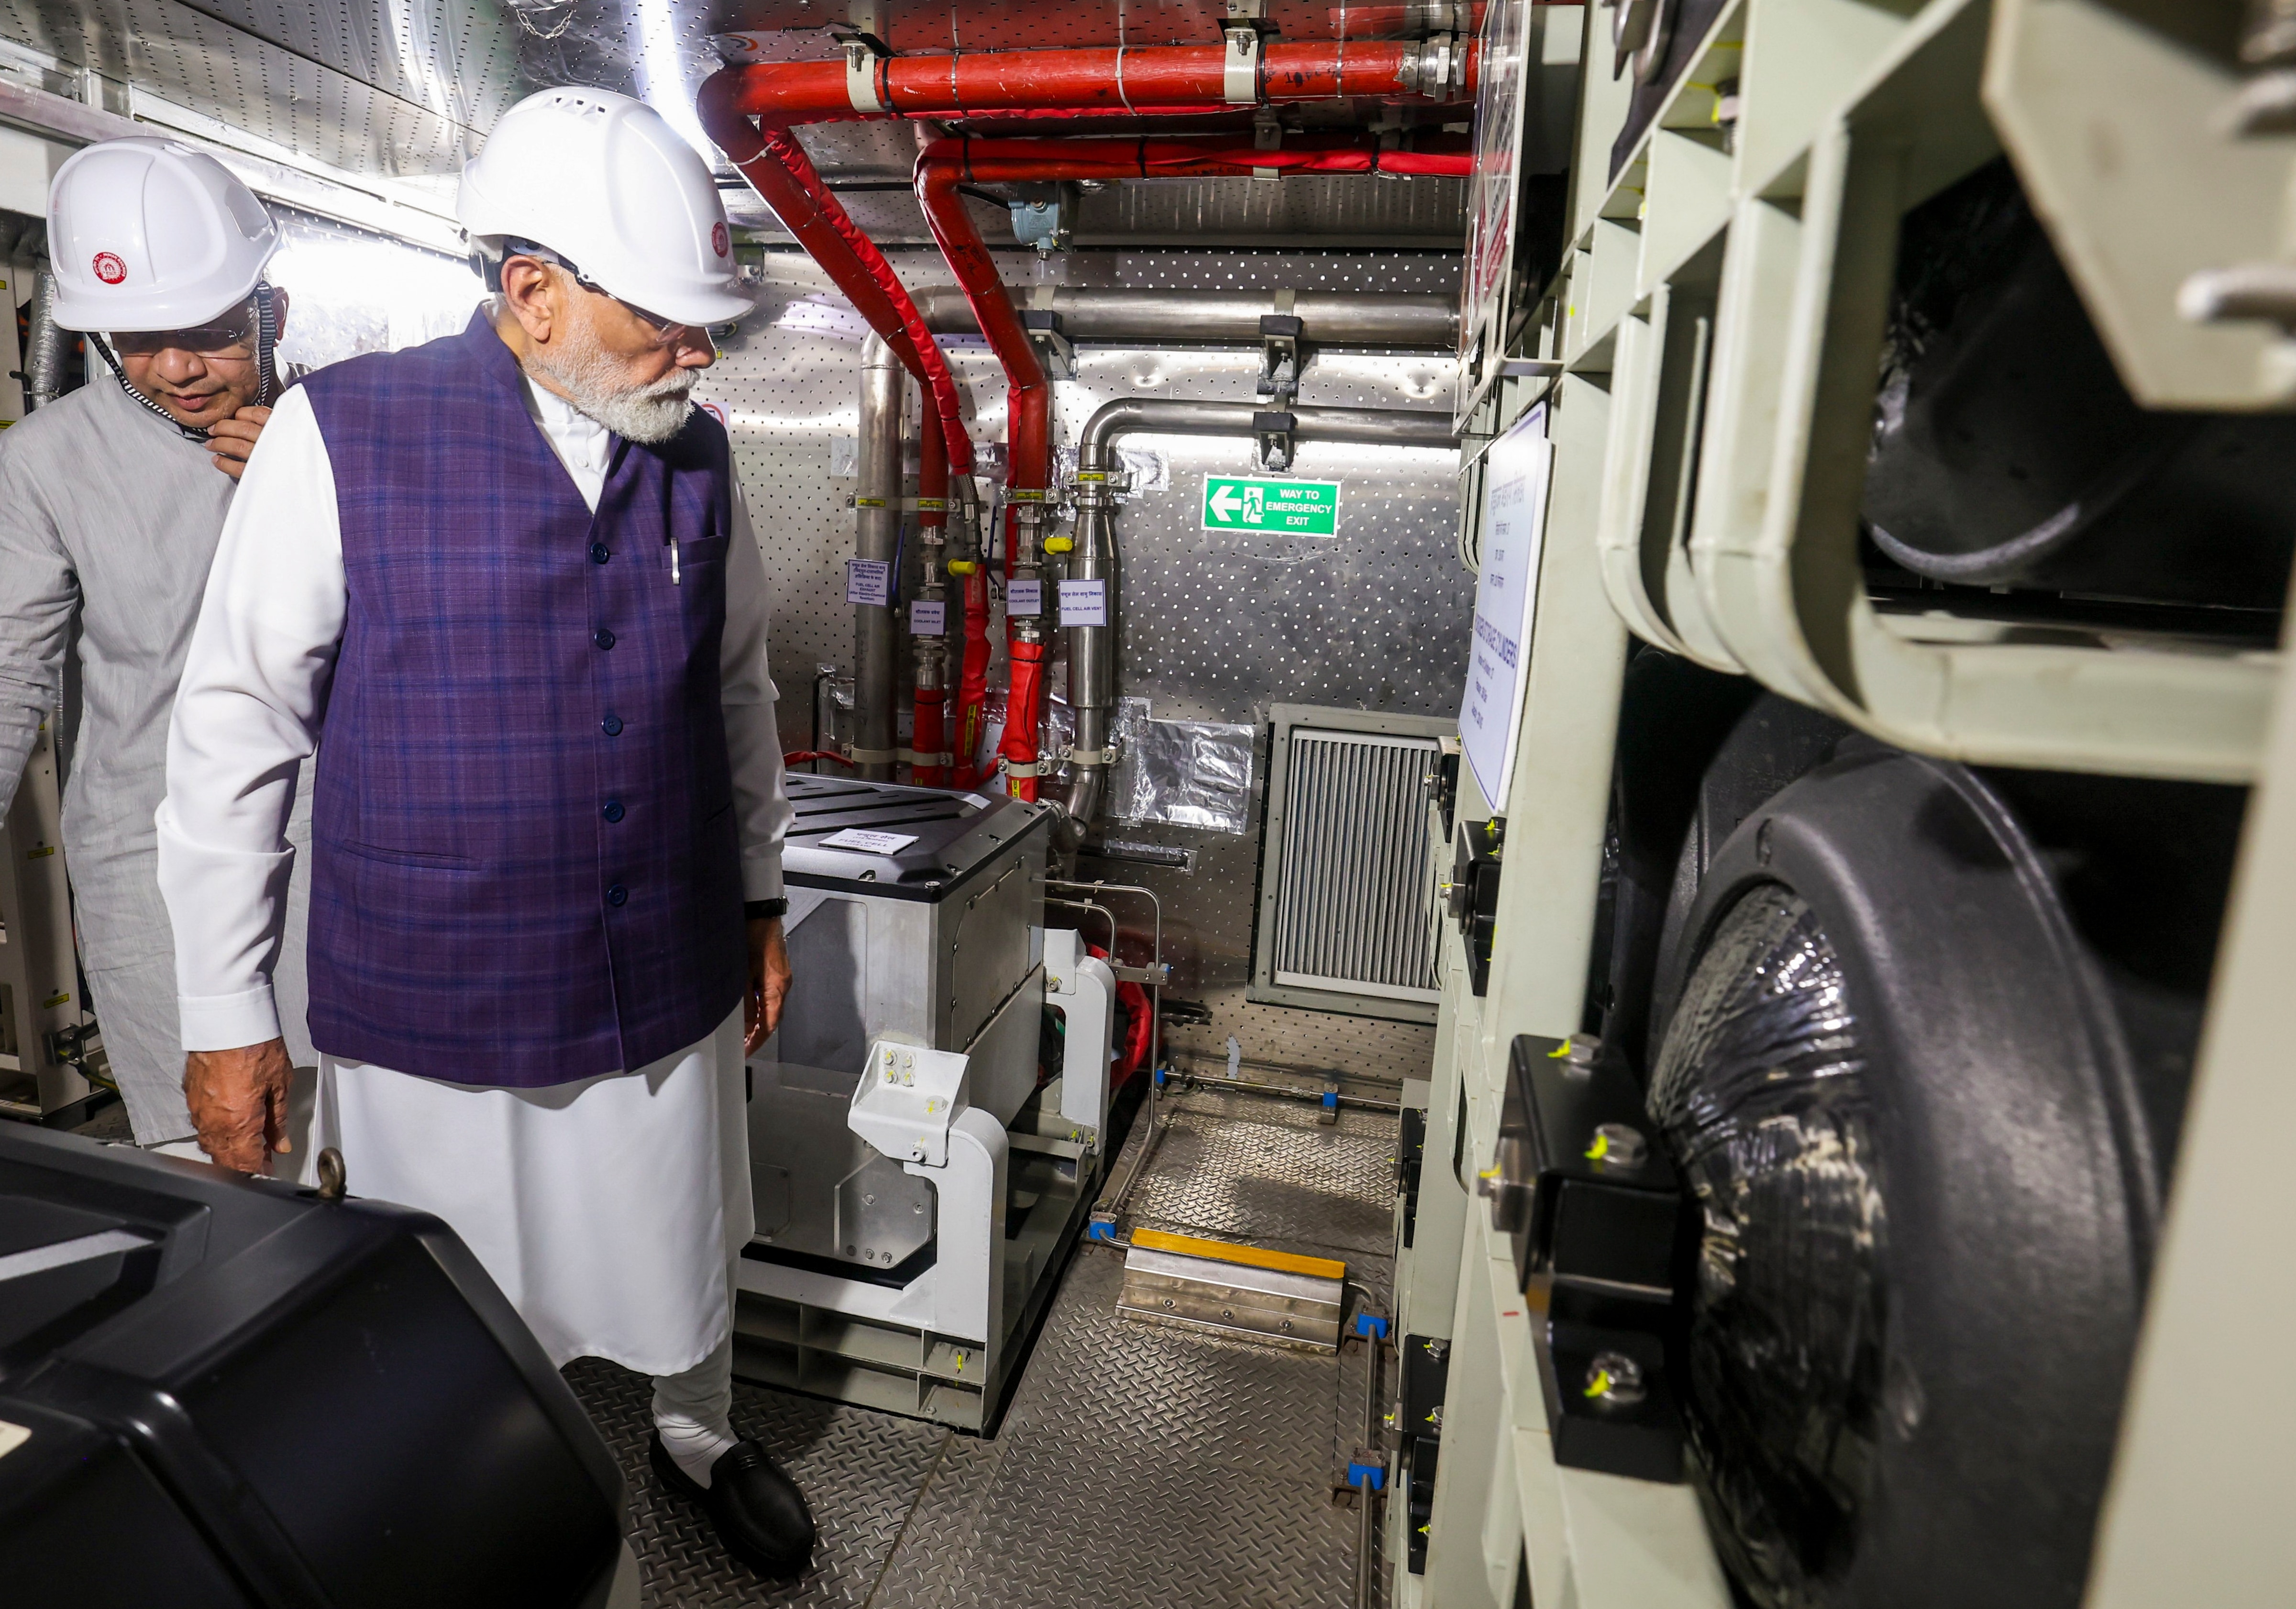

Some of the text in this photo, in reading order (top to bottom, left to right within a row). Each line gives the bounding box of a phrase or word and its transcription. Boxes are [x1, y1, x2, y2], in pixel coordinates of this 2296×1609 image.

[1280, 489, 1320, 500] WAY TO
[1266, 501, 1333, 514] EMERGENCY
[1286, 516, 1310, 526] EXIT
